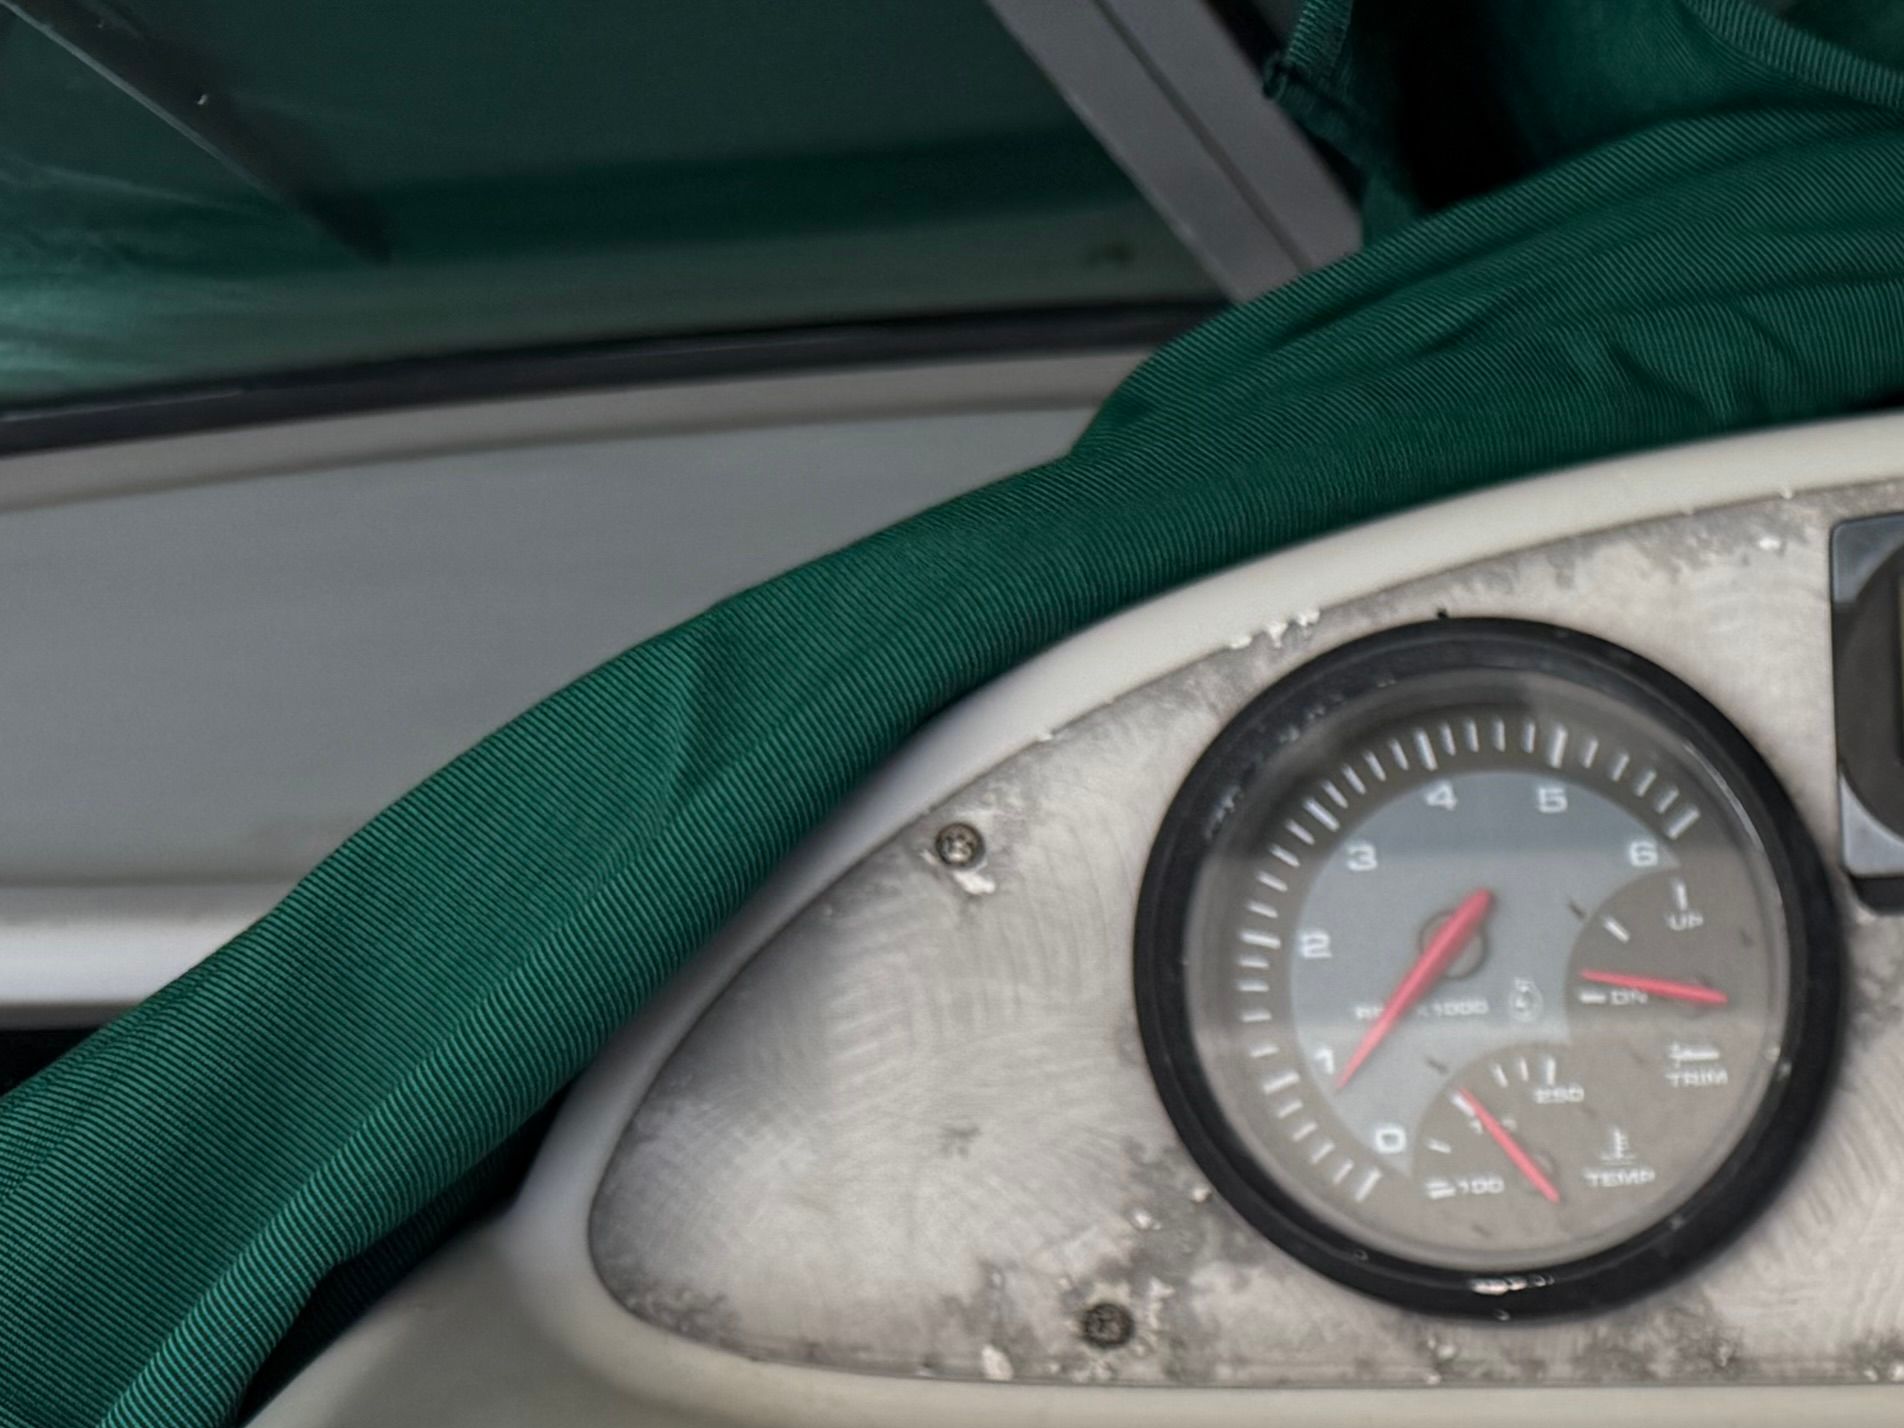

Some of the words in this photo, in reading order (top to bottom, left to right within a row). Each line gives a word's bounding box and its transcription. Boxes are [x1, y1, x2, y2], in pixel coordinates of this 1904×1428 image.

[1426, 784, 1457, 811] 4
[1537, 787, 1568, 814] 5
[1348, 843, 1377, 871] 3
[1630, 840, 1658, 867] 6
[1301, 932, 1332, 959] 2
[1314, 1047, 1336, 1074] 1
[1374, 1125, 1407, 1154] 0
[1584, 1168, 1655, 1187] TEMP
